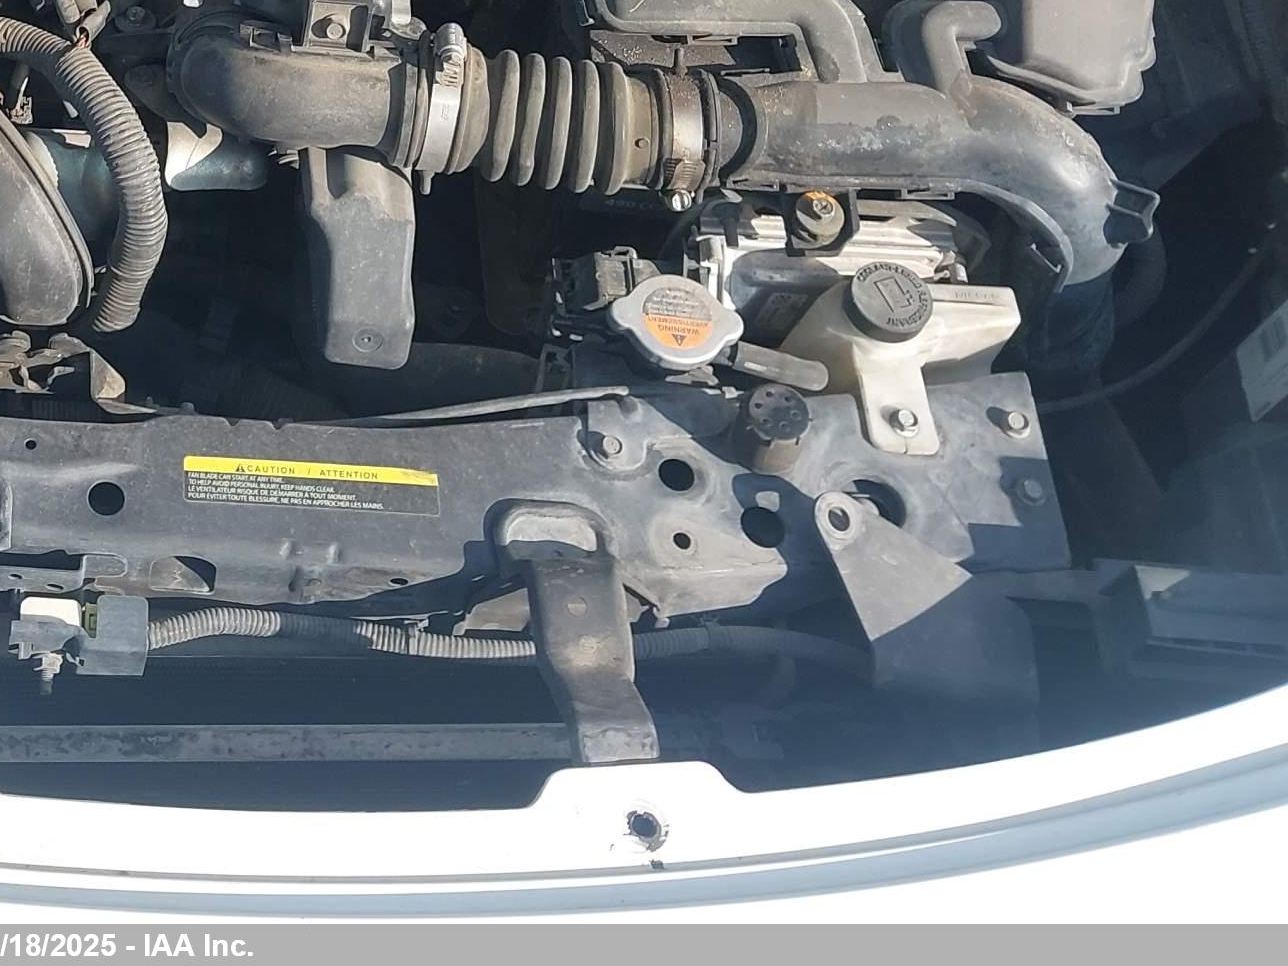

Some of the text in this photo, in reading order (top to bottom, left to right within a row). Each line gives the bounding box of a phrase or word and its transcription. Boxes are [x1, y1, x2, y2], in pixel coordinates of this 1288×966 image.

[658, 324, 700, 336] WARNING
[200, 472, 218, 480] BLADE
[246, 465, 296, 475] CAUTION
[320, 469, 378, 480] ATTENTION
[196, 486, 236, 494] VENTILATEUR
[237, 488, 260, 496] RISQUE
[310, 492, 326, 500] TOUT
[206, 492, 228, 500] ÉVITER
[312, 500, 350, 508] APPROCHER
